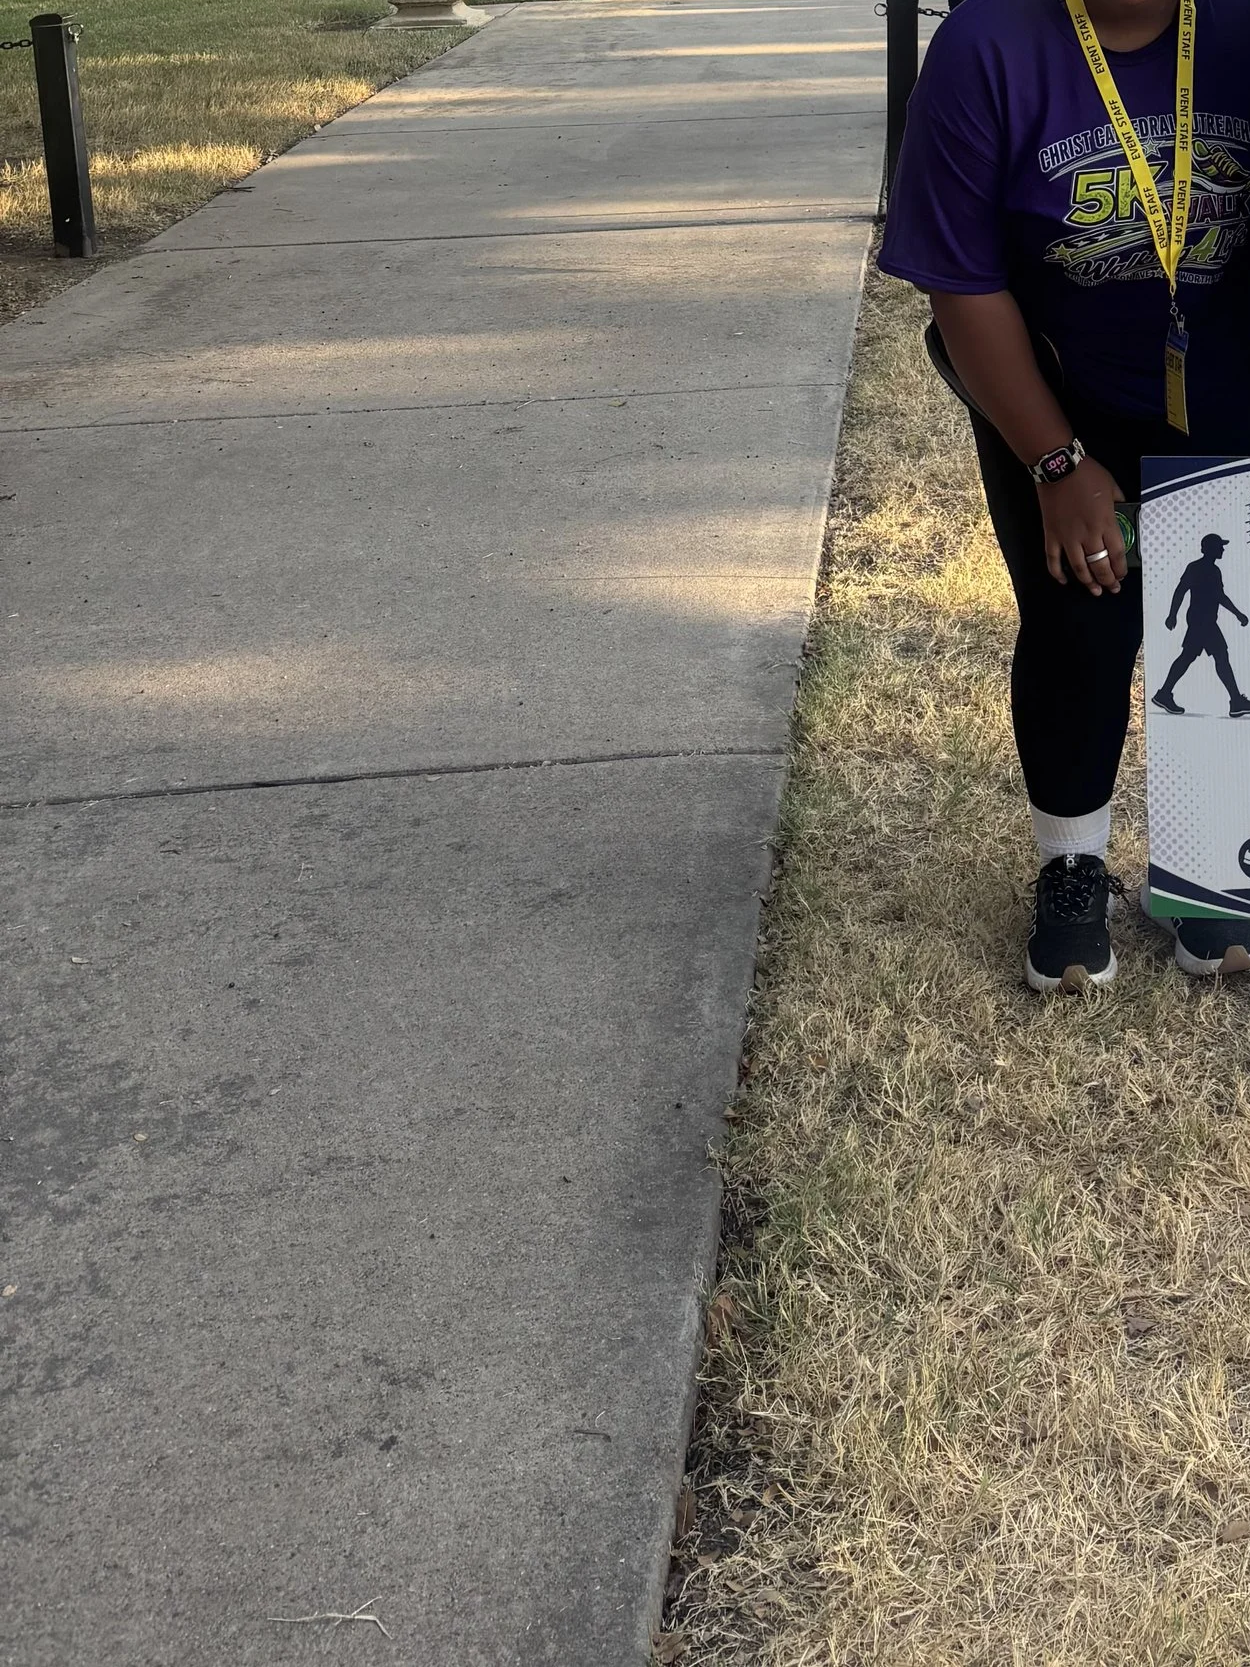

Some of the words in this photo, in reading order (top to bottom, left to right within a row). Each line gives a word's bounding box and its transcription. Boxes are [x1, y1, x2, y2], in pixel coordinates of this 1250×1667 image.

[1074, 13, 1094, 41] STAFF
[1088, 44, 1106, 75] EVENT
[1181, 31, 1191, 61] STAFF
[1109, 99, 1128, 129] STAFF
[1180, 88, 1190, 119] EVENT
[1038, 127, 1094, 172] CHRIST
[1098, 114, 1175, 147] CAEDRAL
[1122, 131, 1141, 161] EVENT
[1179, 122, 1189, 152] STAFF
[1063, 160, 1169, 229] 5K
[1144, 186, 1162, 216] STAFF
[1177, 180, 1187, 212] EVENT
[1153, 224, 1168, 250] EVENT
[1175, 214, 1185, 245] STAFF
